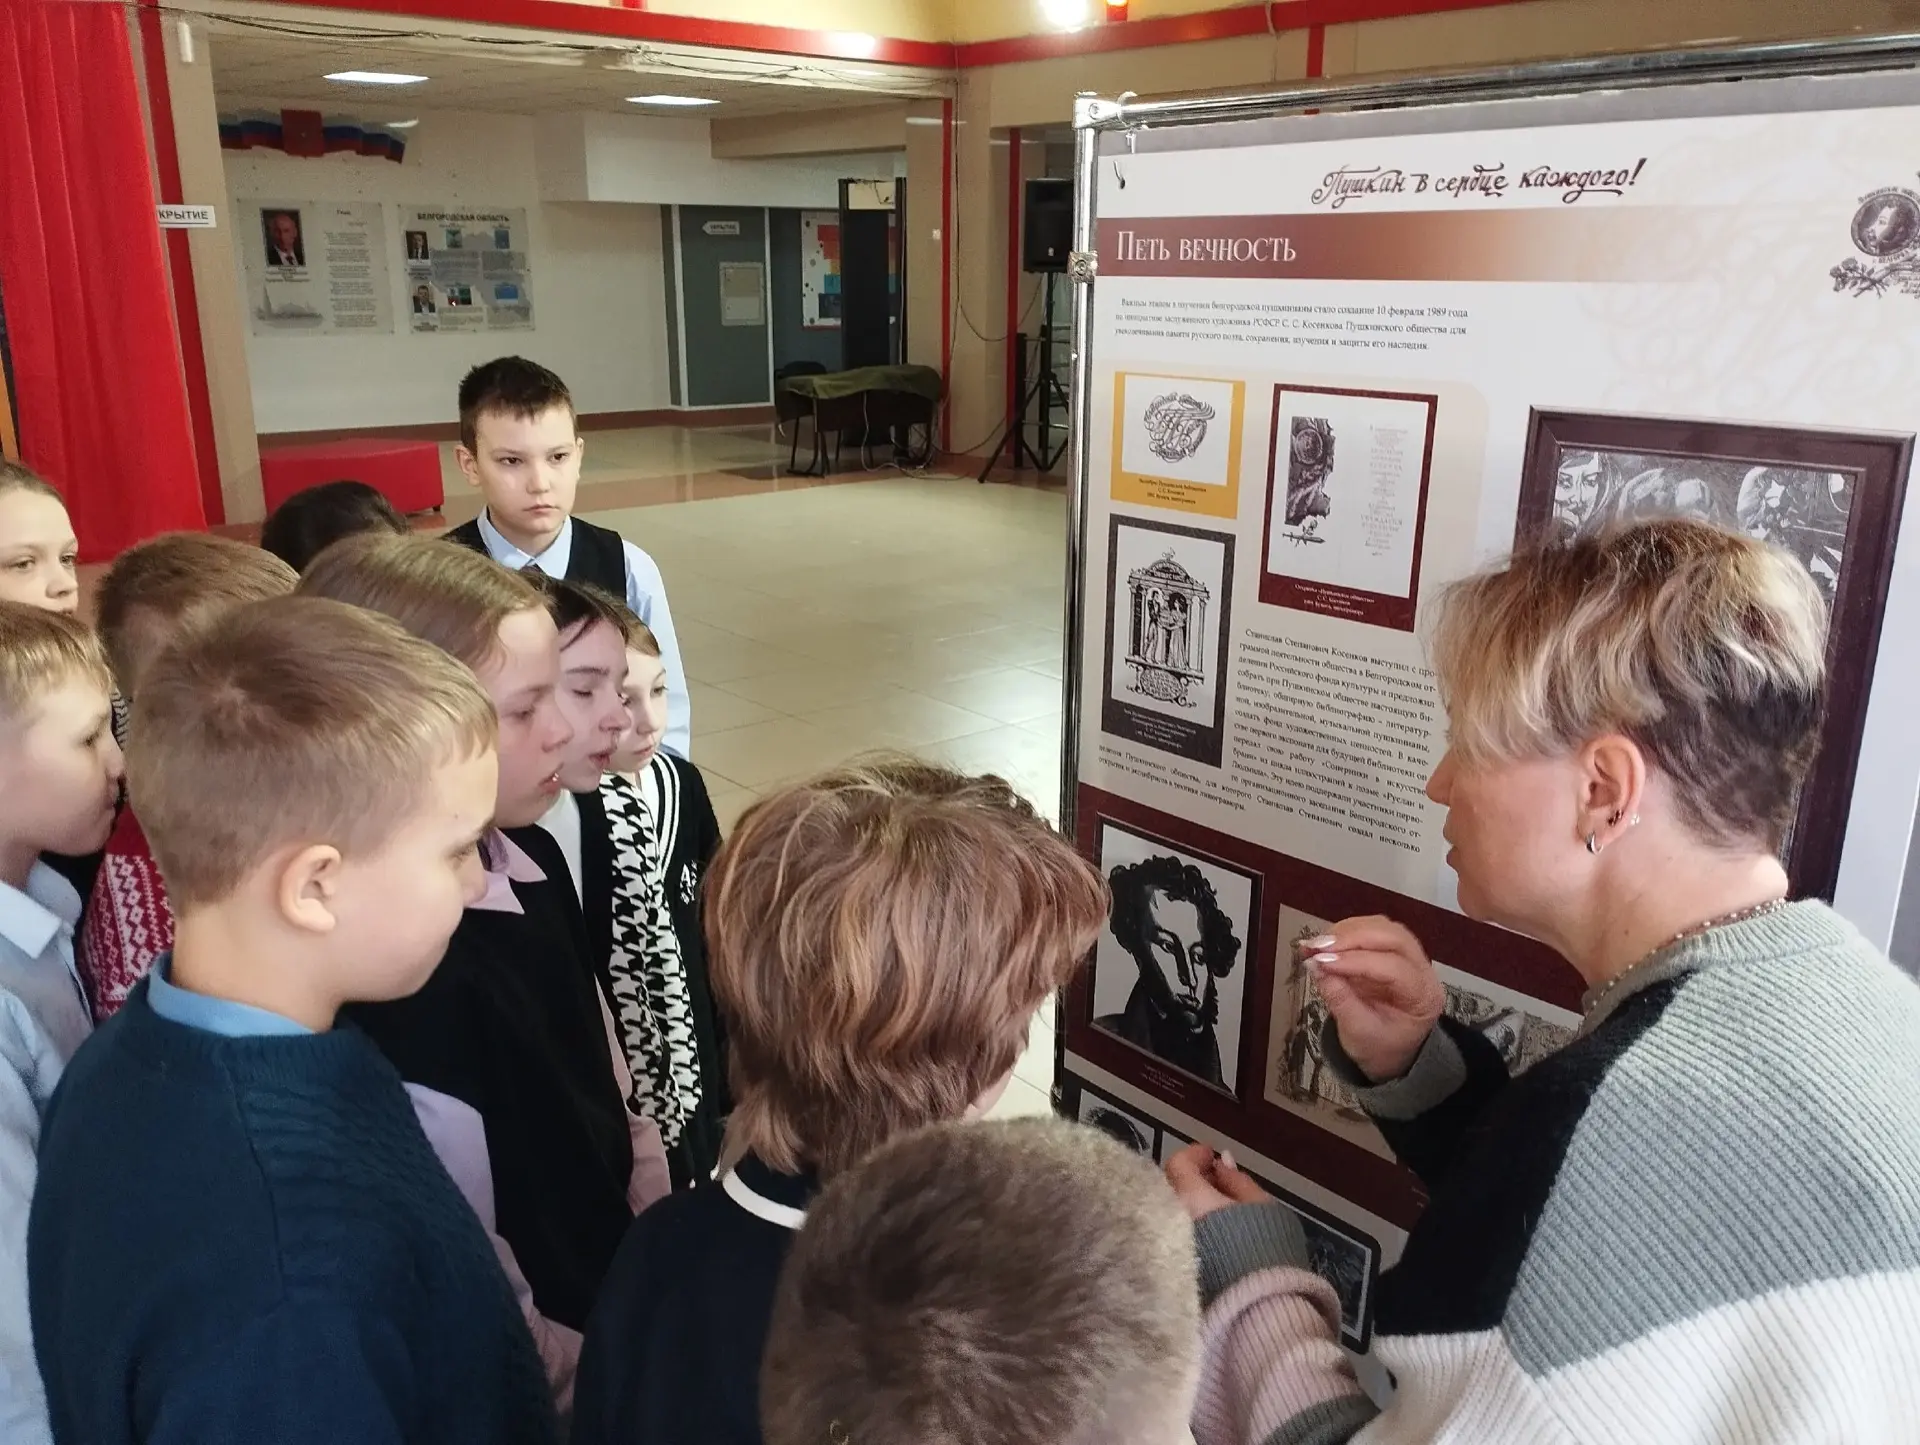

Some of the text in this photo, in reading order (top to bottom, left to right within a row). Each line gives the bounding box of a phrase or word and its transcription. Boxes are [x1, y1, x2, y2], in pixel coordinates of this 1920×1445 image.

[1311, 163, 1405, 209] Пушкин
[1434, 162, 1509, 197] сердце
[1518, 157, 1648, 204] каждого!
[157, 210, 209, 220] КРЫТИЕ
[1211, 300, 1260, 312] белгородской
[1314, 306, 1336, 314] стало
[1337, 307, 1375, 315] создание
[1377, 306, 1386, 315] 10
[1387, 306, 1424, 318] февраля
[1427, 307, 1447, 317] 1989
[1449, 309, 1468, 318] года
[1212, 318, 1251, 328] художника
[1253, 317, 1280, 327] РСФСР
[1281, 319, 1290, 328] С.
[1292, 320, 1300, 329] С.
[1302, 320, 1343, 330] Косенкова
[1345, 321, 1405, 333] Пушкинского
[1406, 323, 1447, 334] общества
[1450, 326, 1466, 335] для
[1191, 332, 1221, 341] русского
[1245, 335, 1291, 345] сохранения,
[1293, 337, 1329, 347] изучения
[1339, 339, 1370, 348] защиты
[1372, 341, 1386, 349] его
[1387, 342, 1430, 351] наследия.
[1239, 642, 1270, 655] граммой
[1271, 650, 1320, 667] деятельности
[1321, 660, 1357, 676] общества
[1365, 669, 1422, 691] Белгородском
[1423, 684, 1436, 693] от-
[1245, 628, 1283, 643] Станислав
[1284, 637, 1329, 654] Степанович
[1331, 647, 1368, 662] Косенков
[1370, 657, 1409, 672] выступил
[1236, 681, 1271, 698] блиотеку,
[1273, 692, 1314, 708] обширную
[1316, 701, 1376, 724] библиографию
[1385, 720, 1432, 739] литератур-
[1237, 669, 1434, 722] собрать при Пушкинском обществе настоящую би-
[1269, 661, 1314, 680] Российского
[1315, 673, 1340, 686] фонда
[1341, 680, 1379, 696] культуры
[1388, 691, 1435, 708] предложил
[1234, 710, 1429, 767] создать фонд художественных ценностей. В каче-
[1234, 723, 1248, 732] стве
[1249, 727, 1277, 739] первого
[1279, 735, 1315, 750] экспоната
[1316, 745, 1329, 755] для
[1330, 748, 1366, 765] будущей
[1367, 758, 1415, 778] библиотеки
[1236, 696, 1430, 753] ной, изобразительной, музыкальной пушкинианы,
[1131, 767, 1168, 786] экслибрисов
[1233, 736, 1261, 748] передал
[1266, 745, 1285, 755] свою
[1289, 752, 1315, 766] работу
[1321, 761, 1369, 780] «Соперники
[1386, 779, 1426, 796] искусстве
[1233, 747, 1257, 760] брани»
[1260, 757, 1268, 765] из
[1270, 760, 1292, 772] цикла
[1294, 767, 1346, 787] иллюстраций
[1356, 784, 1379, 798] поэме
[1382, 791, 1415, 808] «Руслан
[1418, 803, 1424, 811] и
[1125, 752, 1167, 772] Пушкинского
[1170, 767, 1201, 784] общества,
[1205, 780, 1217, 789] для
[1221, 785, 1252, 800] которого
[1256, 795, 1294, 813] Станислав
[1298, 808, 1343, 829] Степанович
[1348, 825, 1373, 839] создал
[1379, 835, 1421, 853] несколько
[1240, 778, 1307, 803] организационного
[1309, 799, 1346, 815] заседания
[1349, 809, 1406, 834] Белгородского
[1409, 830, 1421, 838] от-
[1270, 772, 1283, 784] Эту
[1285, 779, 1304, 789] идею
[1305, 784, 1352, 804] поддержали
[1353, 798, 1395, 817] участники
[1396, 811, 1424, 824] перво-
